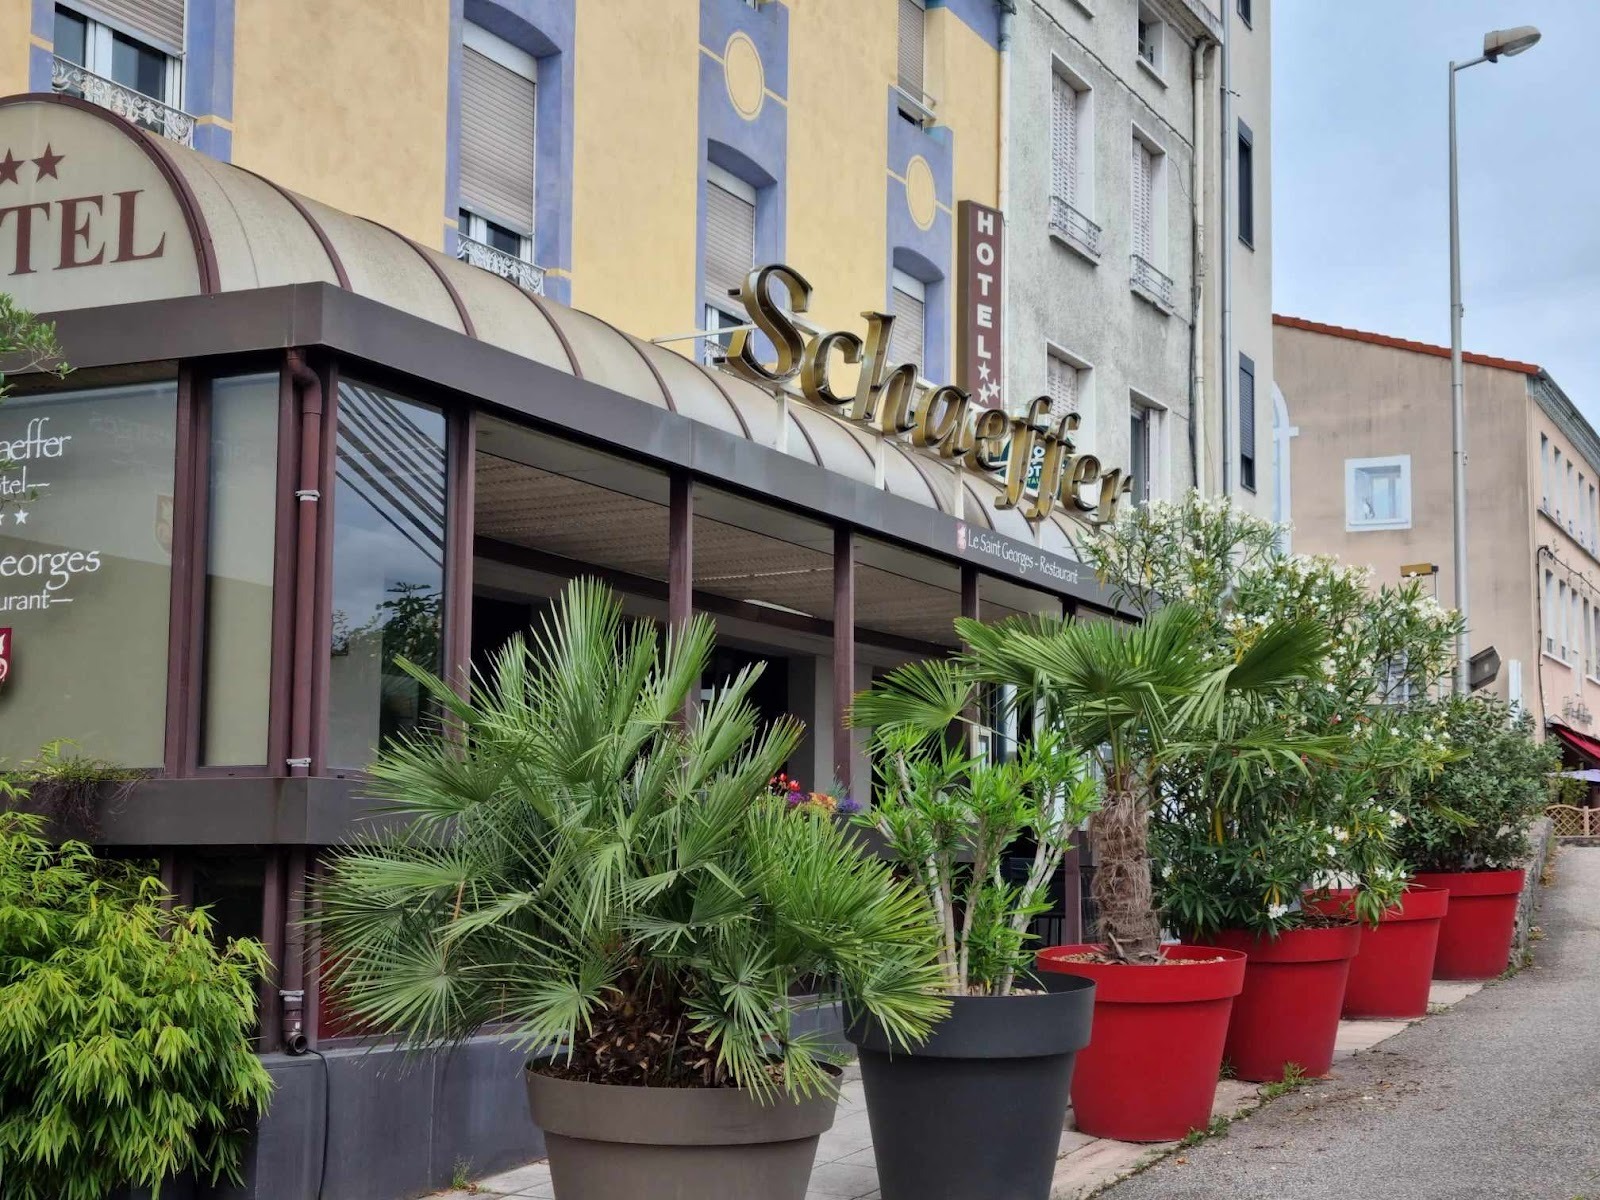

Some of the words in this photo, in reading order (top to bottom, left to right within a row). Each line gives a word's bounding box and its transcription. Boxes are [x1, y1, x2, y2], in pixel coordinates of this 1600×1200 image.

[976, 210, 995, 360] HOTEL
[714, 264, 1134, 526] Schaeffer
[968, 528, 980, 550] Le
[980, 534, 1001, 557] Saint
[1002, 542, 1034, 574] Georges
[1040, 556, 1078, 584] Restaurant
